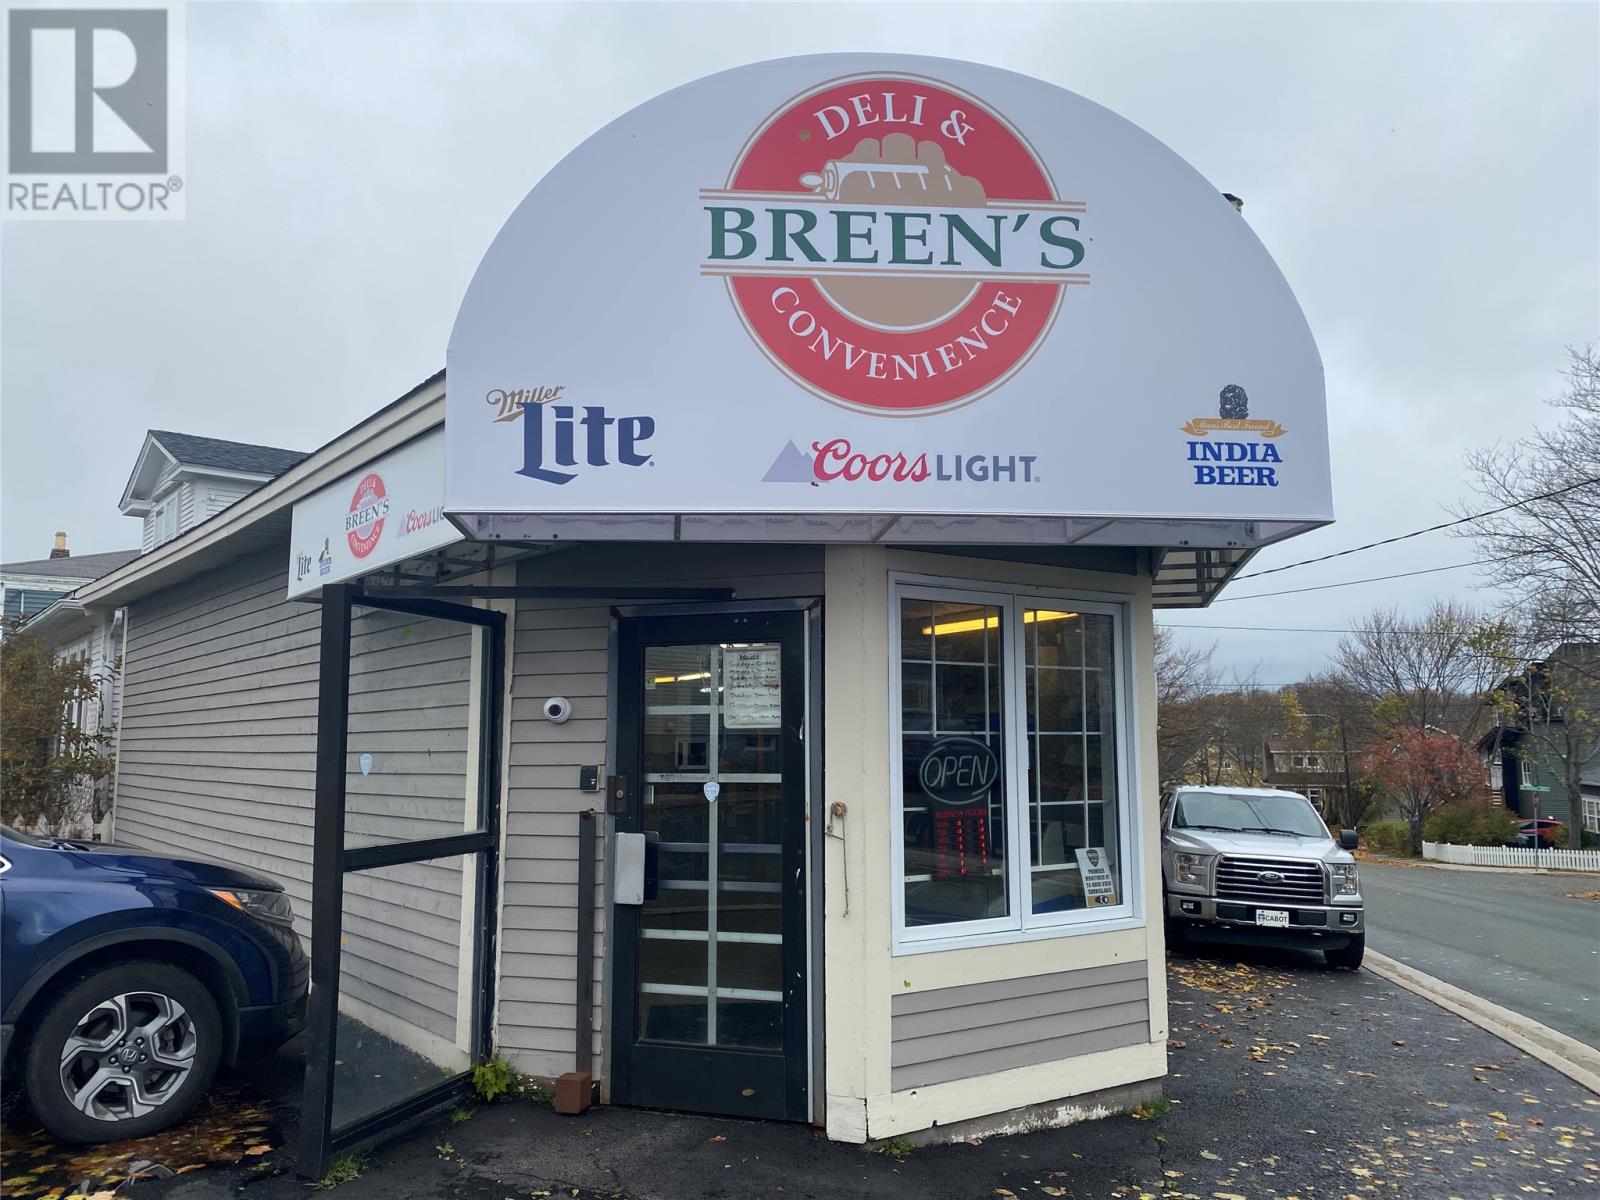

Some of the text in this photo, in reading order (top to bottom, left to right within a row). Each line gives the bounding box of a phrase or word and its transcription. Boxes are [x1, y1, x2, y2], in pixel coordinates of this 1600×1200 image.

[813, 92, 975, 146] DELI &
[703, 205, 1086, 270] BREEN'S
[770, 285, 1023, 381] CONVENIENCE
[486, 384, 567, 418] Miller
[514, 402, 655, 485] Lite
[1186, 441, 1283, 463] INDIA
[811, 438, 1038, 483] Coors LIGHT
[1193, 465, 1279, 487] BEER
[345, 498, 389, 531] BREEN'S
[406, 505, 445, 534] Coors LIG
[297, 555, 311, 582] Lite
[924, 755, 989, 788] OPEN
[1265, 914, 1288, 923] CABOT
